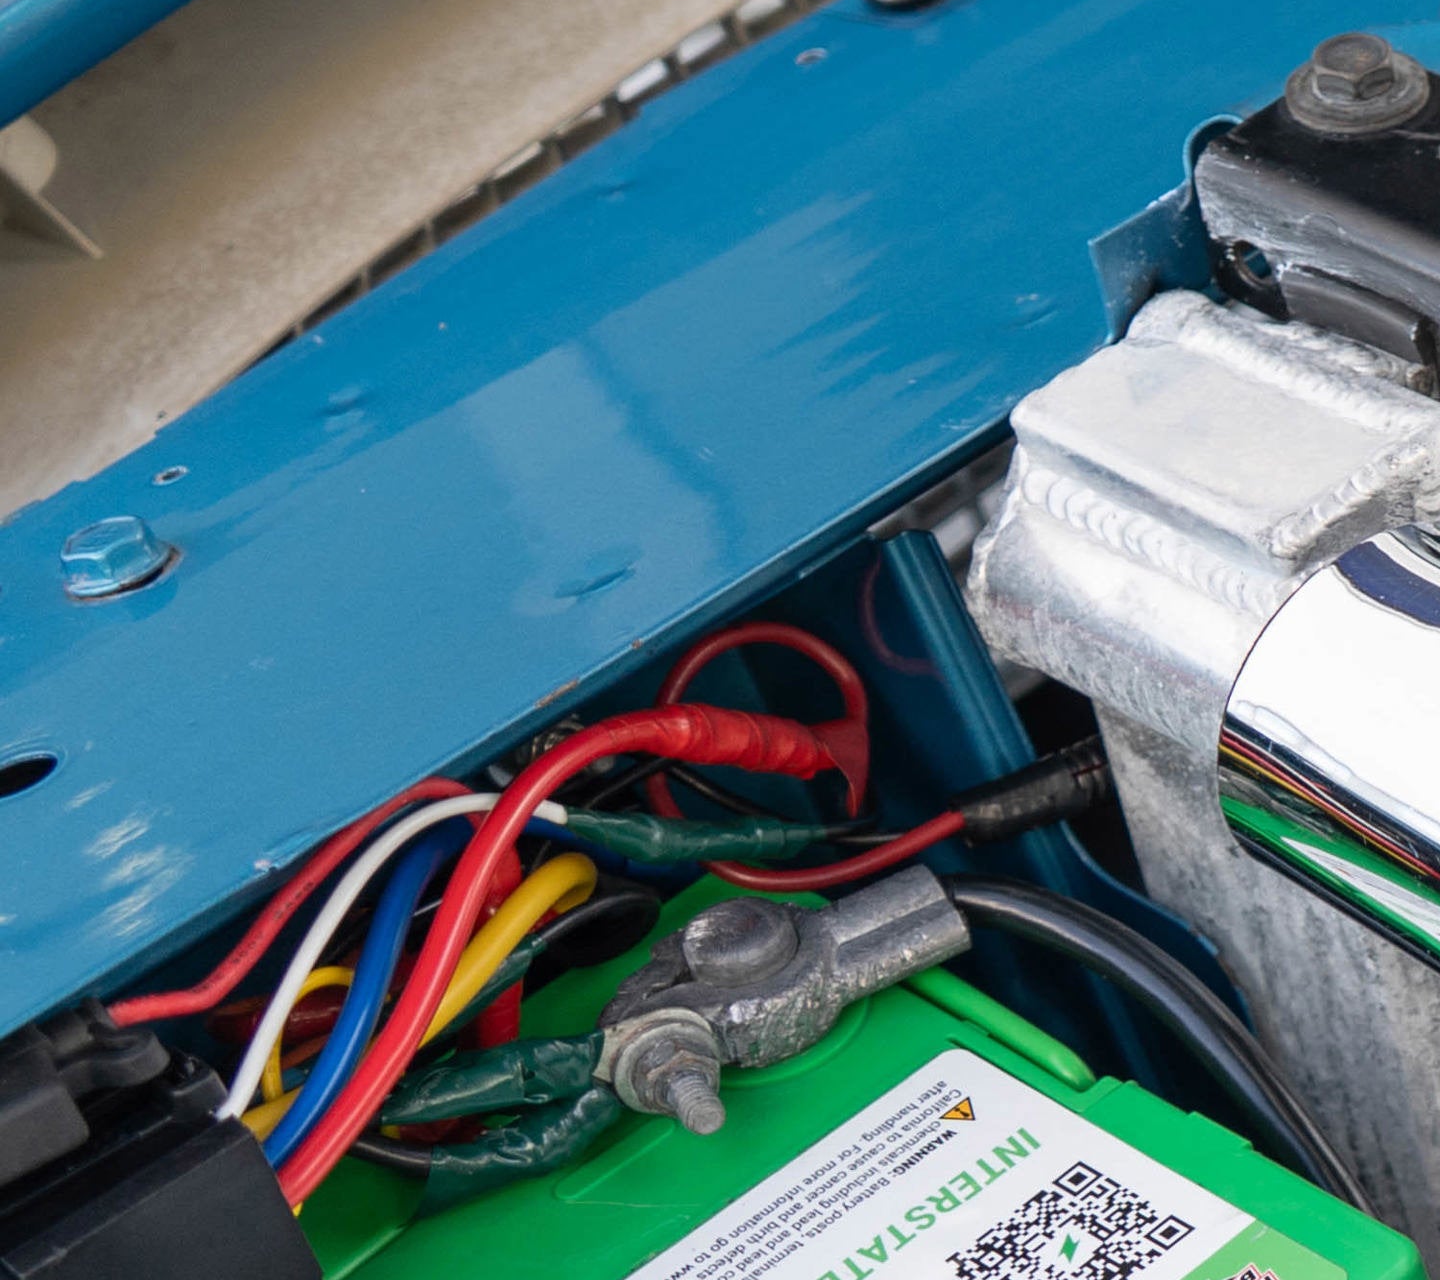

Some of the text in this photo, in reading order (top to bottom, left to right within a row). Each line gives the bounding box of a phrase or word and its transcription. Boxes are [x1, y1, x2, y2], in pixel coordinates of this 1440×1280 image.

[915, 1080, 948, 1103] after
[857, 1102, 920, 1143] handling.
[899, 1088, 963, 1132] California
[876, 1120, 942, 1167] chemicals
[885, 1131, 903, 1143] to
[836, 1143, 862, 1161] For
[846, 1142, 886, 1171] cause
[887, 1129, 957, 1177] WARNING:
[801, 1159, 837, 1185] more
[803, 1170, 848, 1203] cancer
[817, 1165, 880, 1209] including
[840, 1176, 891, 1212] Battery
[727, 1184, 805, 1239] information
[776, 1201, 805, 1223] and
[790, 1207, 823, 1232] lead
[799, 1208, 844, 1239] posts,
[707, 1236, 729, 1252] go
[745, 1220, 781, 1245] birth
[764, 1229, 792, 1251] and
[692, 1251, 712, 1264] to
[695, 1243, 748, 1280] defects
[734, 1247, 768, 1272] lead
